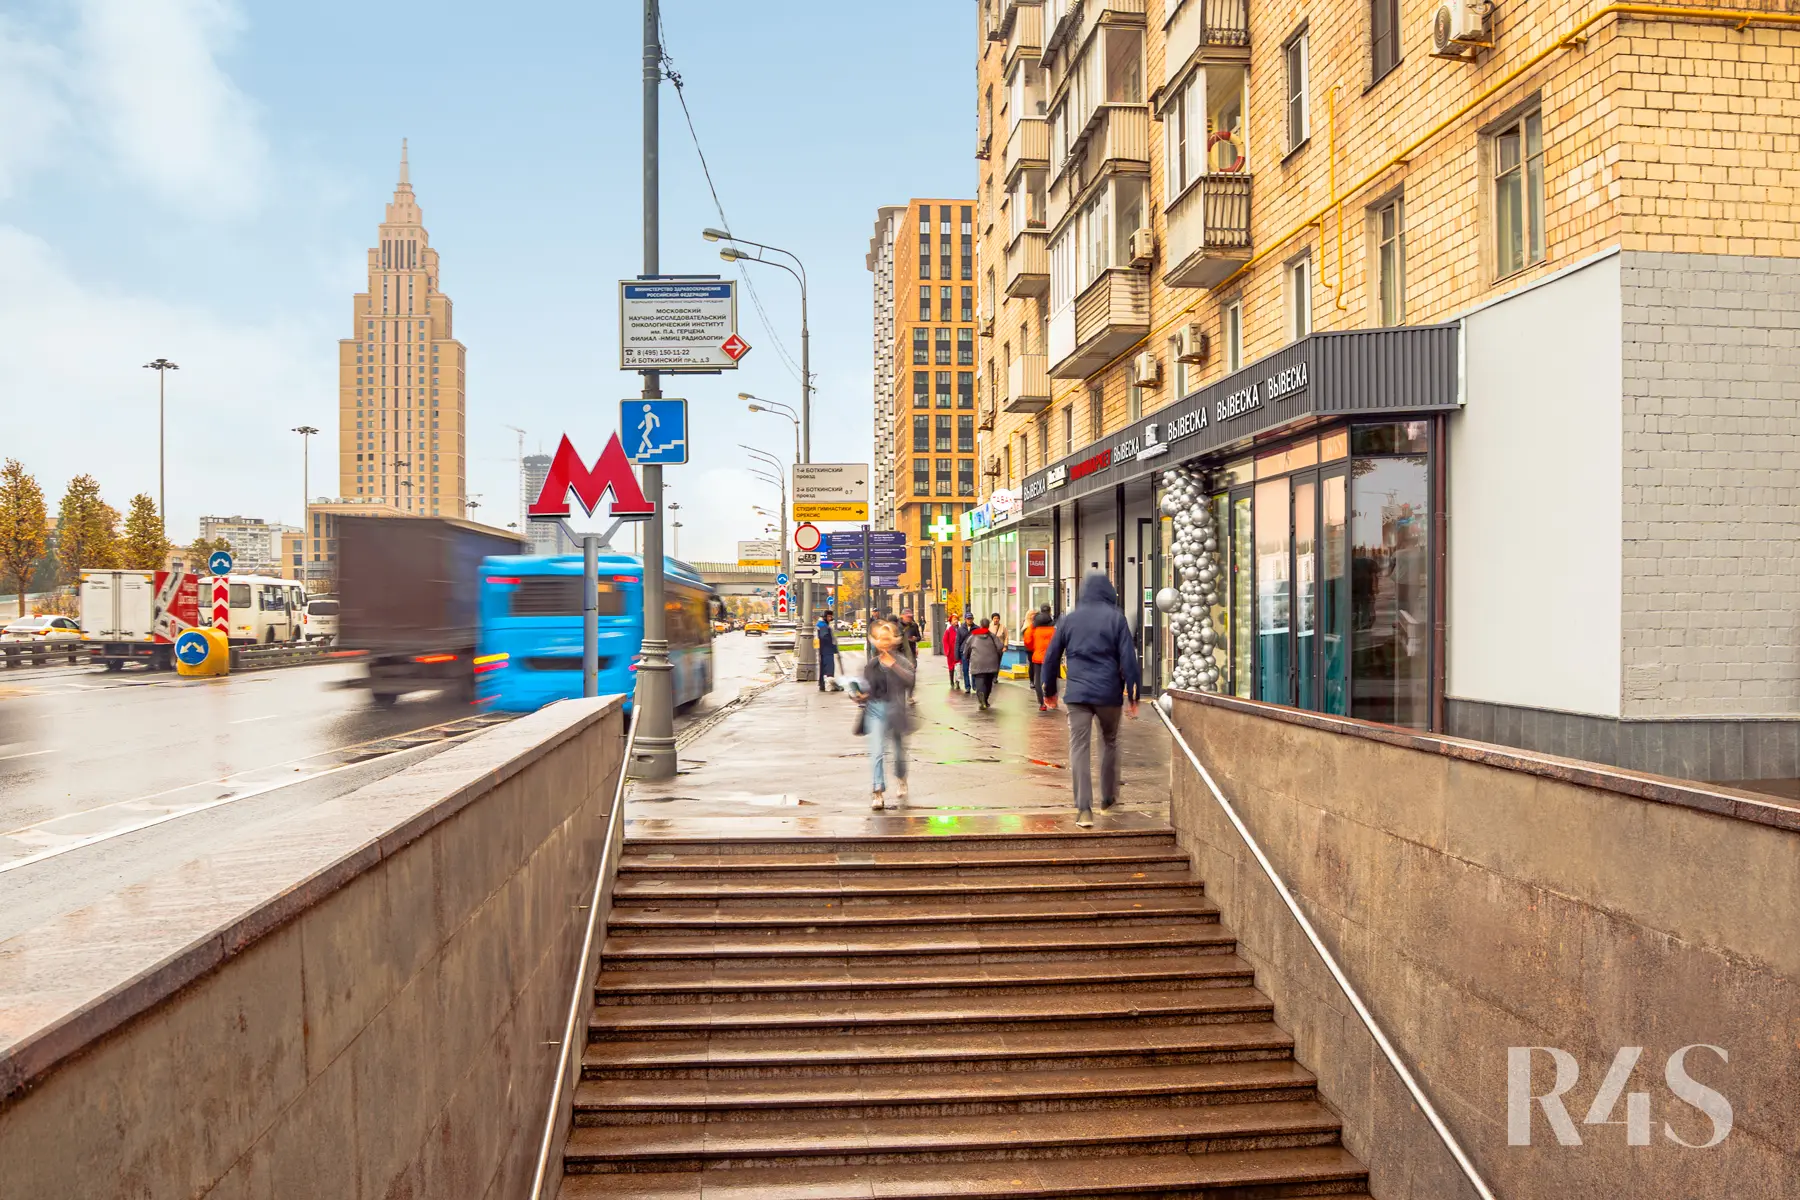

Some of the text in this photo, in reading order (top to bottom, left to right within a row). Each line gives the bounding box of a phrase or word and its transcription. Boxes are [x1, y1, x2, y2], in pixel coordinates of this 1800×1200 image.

[1268, 362, 1308, 400] ВЫВЕСКА
[1216, 384, 1259, 422] ВЫВЕСКА
[1168, 407, 1208, 440] ВЫВЕСКА
[1114, 436, 1140, 464] ВЫВЕСКА
[1024, 478, 1046, 500] ВЫВЕСКА
